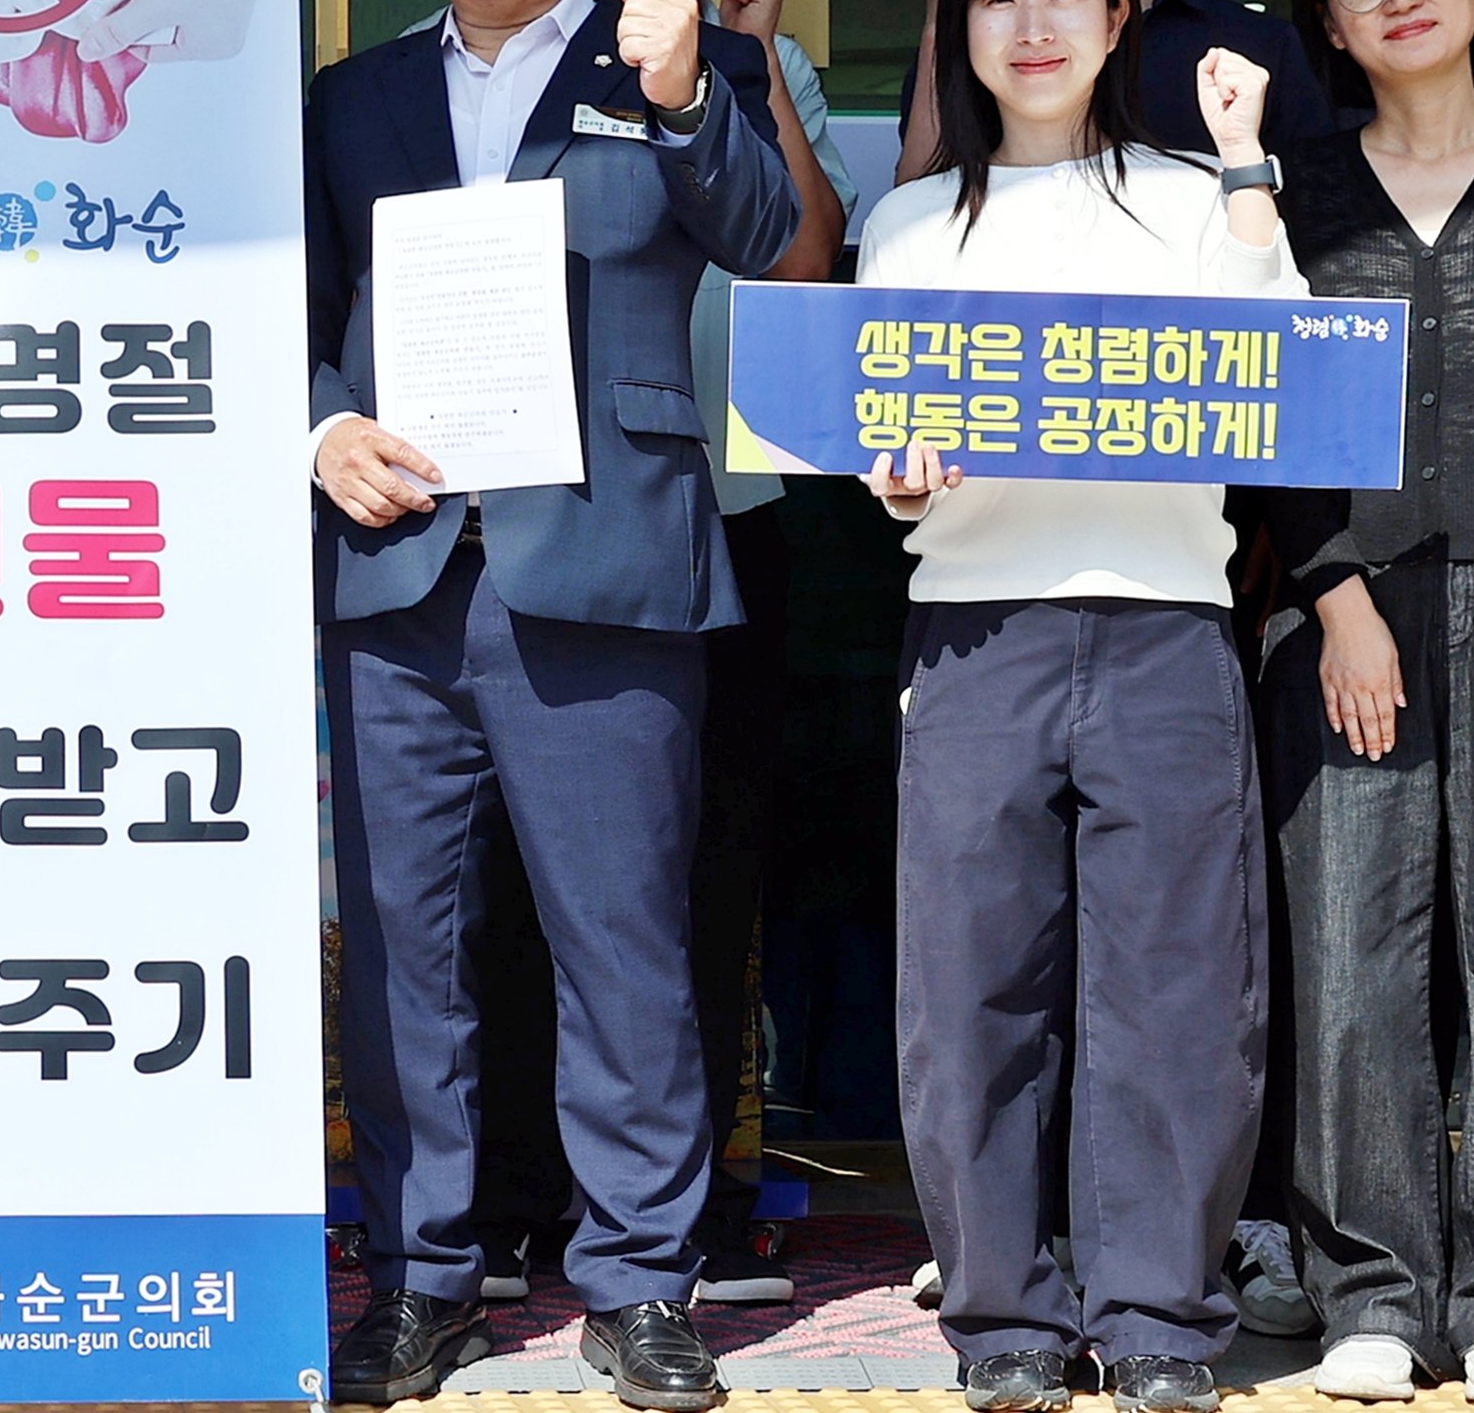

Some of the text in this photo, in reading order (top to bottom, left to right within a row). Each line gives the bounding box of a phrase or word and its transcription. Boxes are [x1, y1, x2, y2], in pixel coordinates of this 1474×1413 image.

[62, 182, 186, 263] 화순
[855, 320, 1281, 390] 생각은 청렴하게!
[854, 388, 1277, 460] 행동은 공정하게!
[129, 1326, 210, 1349] Council
